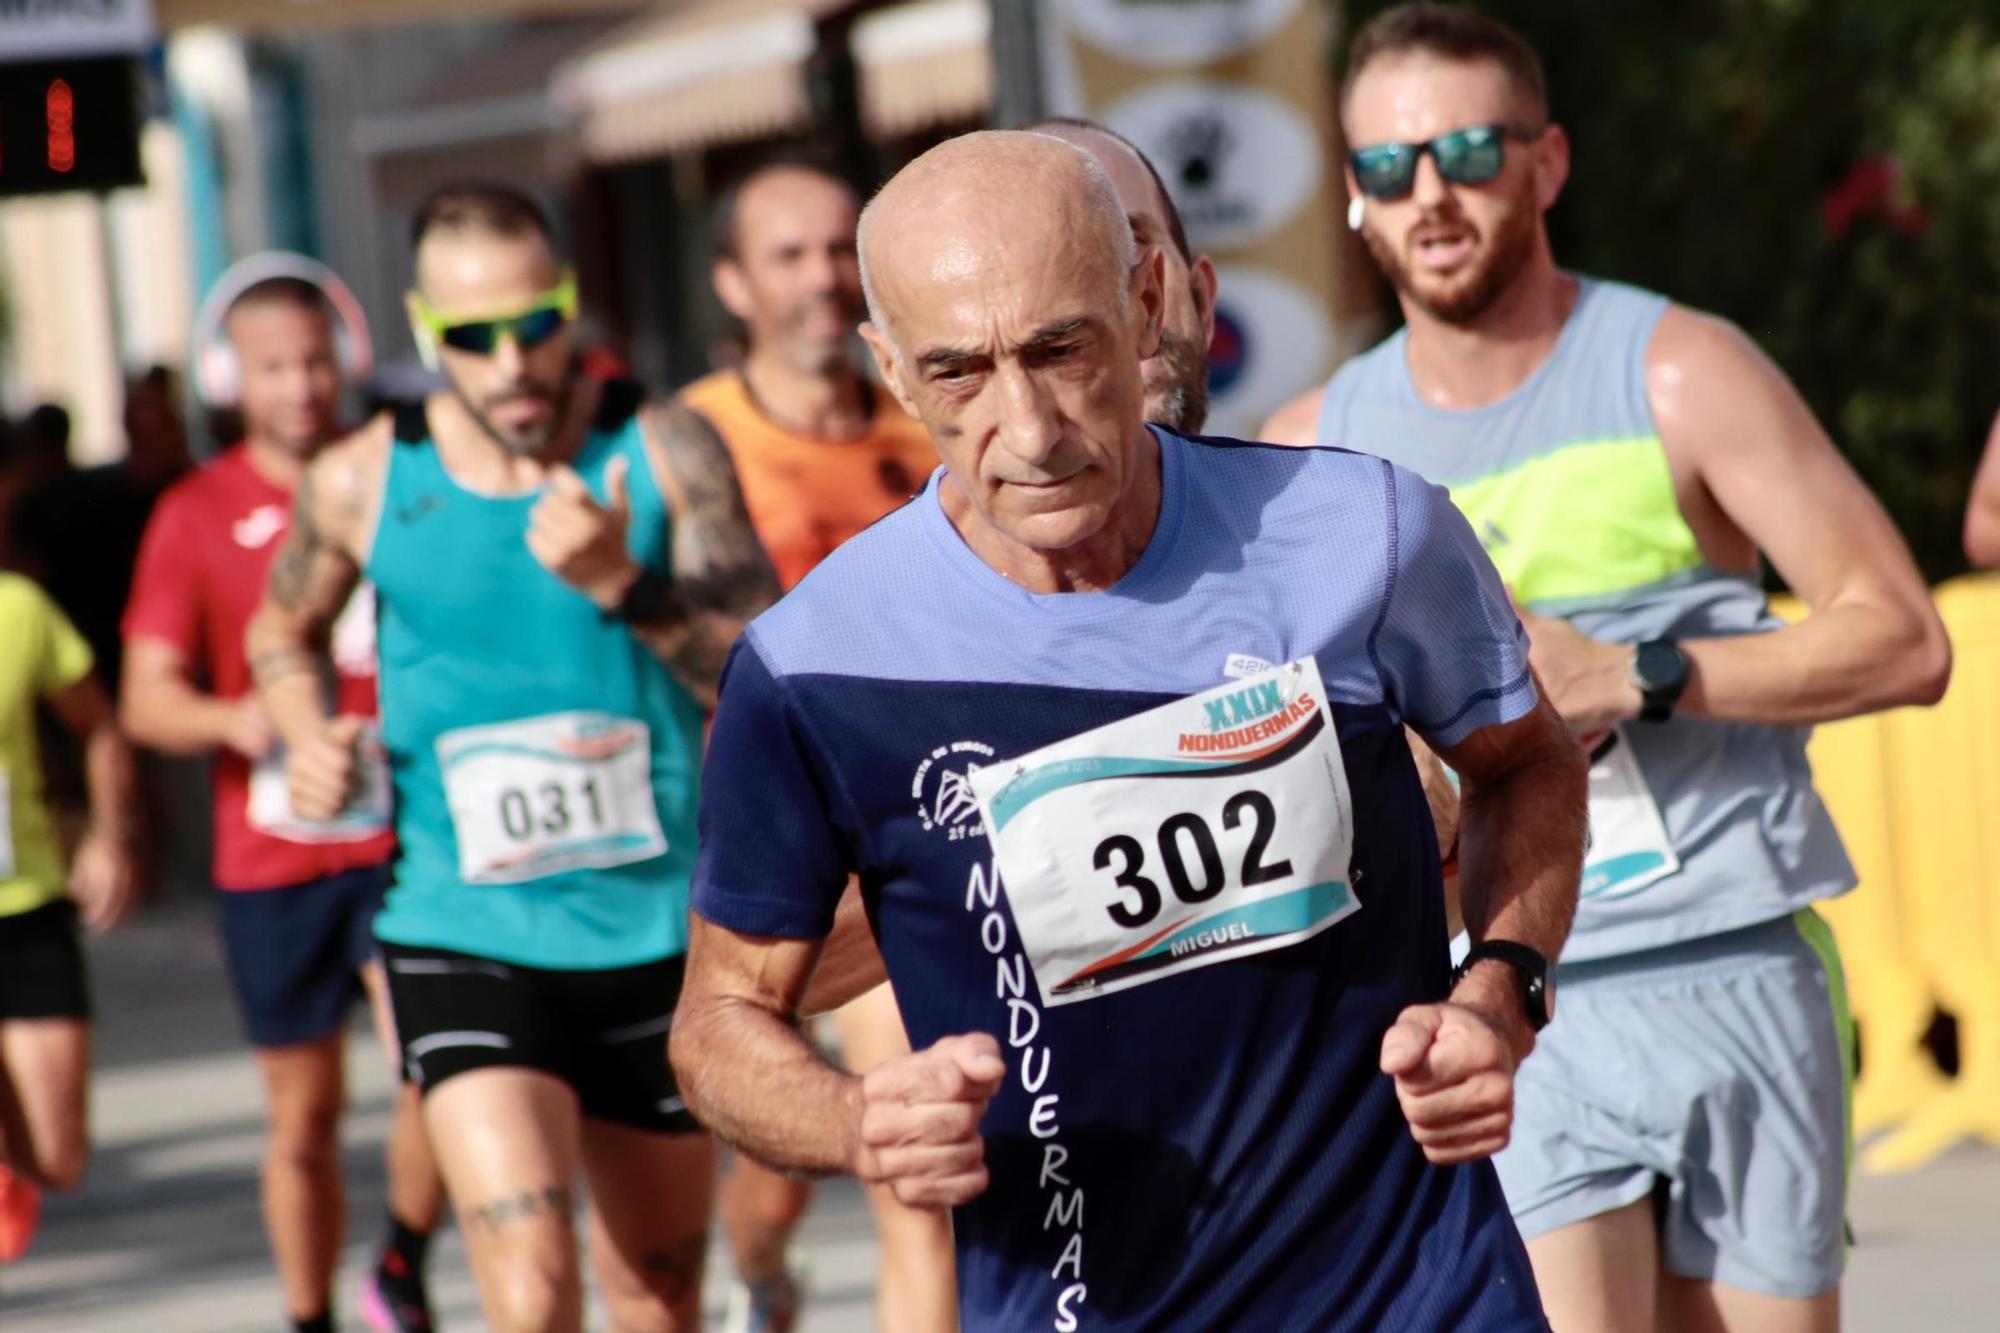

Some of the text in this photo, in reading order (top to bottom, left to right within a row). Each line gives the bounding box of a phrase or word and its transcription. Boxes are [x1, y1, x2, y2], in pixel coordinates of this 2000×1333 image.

[1178, 692, 1317, 751] NONDUERMAS
[1203, 679, 1285, 732] XXIX
[500, 778, 605, 840] 031
[1093, 789, 1294, 929] 302
[1170, 921, 1256, 957] MIGUEL
[965, 858, 1087, 1333] NONDUERMAS
